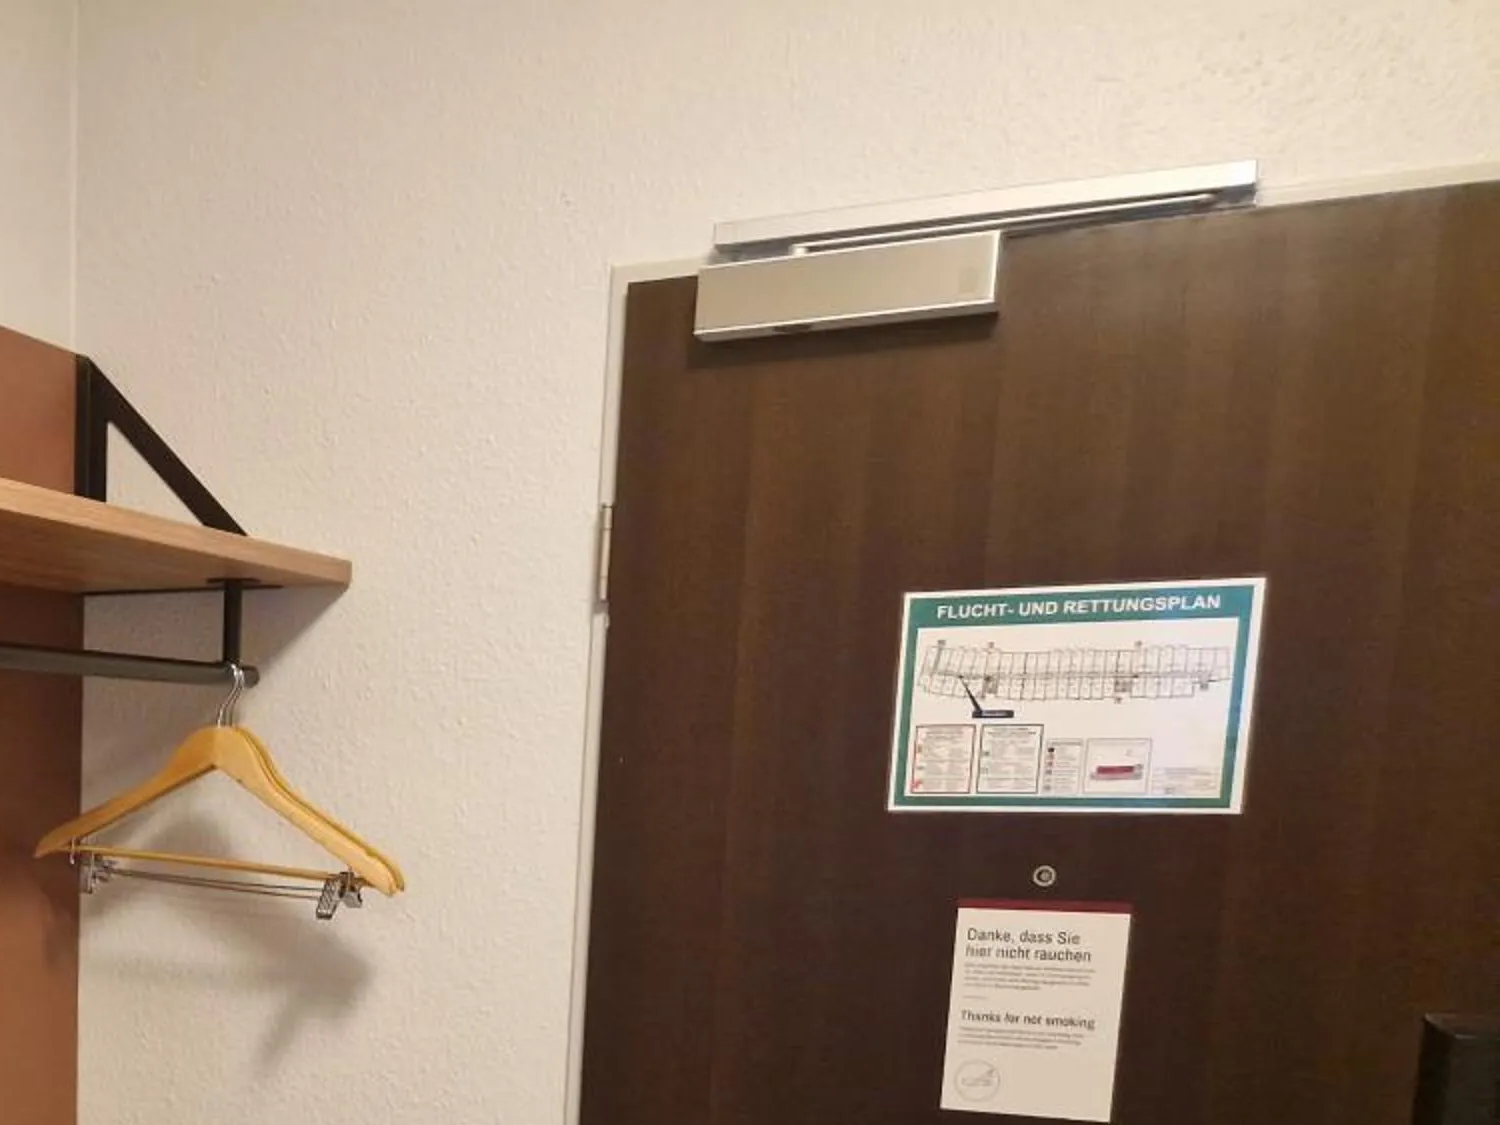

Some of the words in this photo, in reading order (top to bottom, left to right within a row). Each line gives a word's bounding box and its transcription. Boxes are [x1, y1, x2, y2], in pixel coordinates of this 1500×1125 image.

[936, 603, 1014, 619] FLUCHT-
[1018, 600, 1058, 616] UND
[1063, 595, 1221, 614] RETTUNGSPLAN
[967, 927, 1014, 944] Danke,
[1019, 929, 1053, 944] dass
[1057, 931, 1082, 945] Sie
[965, 945, 992, 958] hier
[995, 946, 1030, 960] nicht
[1034, 948, 1092, 963] rauchen
[961, 1009, 1002, 1024] Thanks
[1003, 1011, 1020, 1025] for
[1023, 1014, 1043, 1026] not
[1045, 1015, 1096, 1031] smoking
